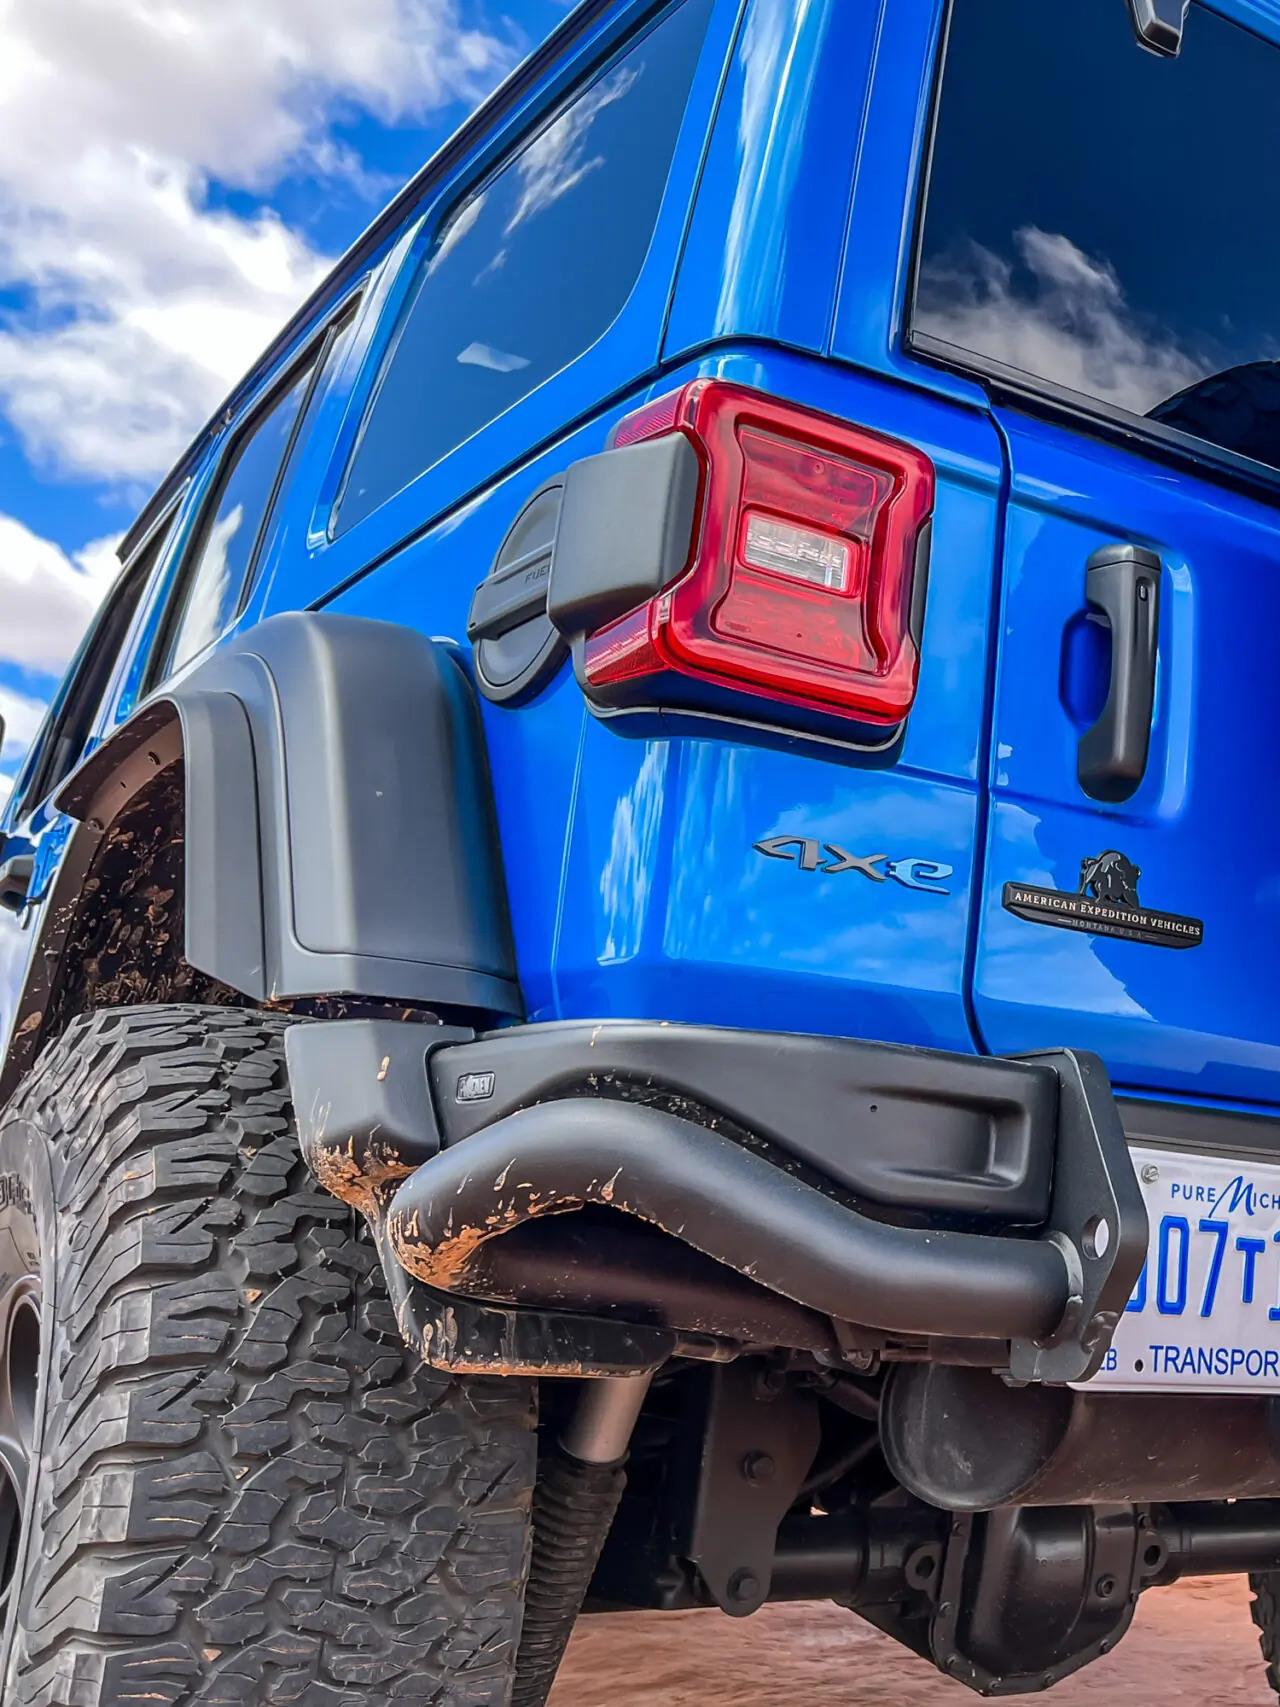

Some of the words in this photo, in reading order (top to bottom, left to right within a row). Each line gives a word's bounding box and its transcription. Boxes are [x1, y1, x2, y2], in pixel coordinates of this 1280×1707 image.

[1014, 891, 1077, 912] AMERICAN
[1080, 902, 1147, 925] EXPEDITION
[1150, 917, 1201, 936] VEHICLES
[1171, 1183, 1217, 1203] PURE
[1099, 1347, 1118, 1371] B
